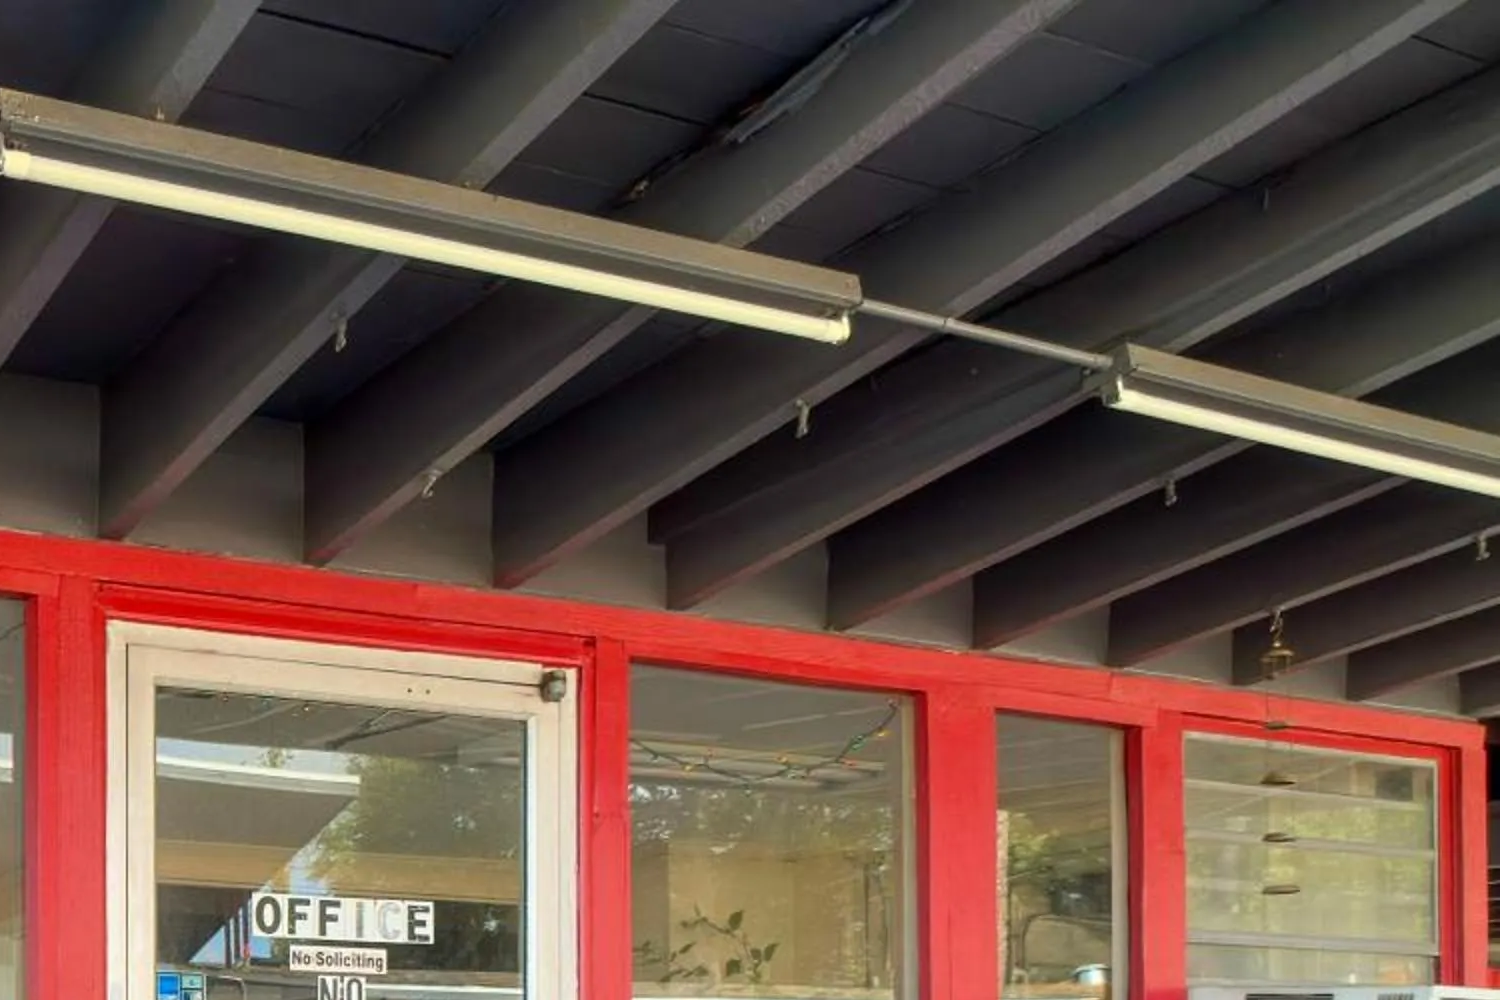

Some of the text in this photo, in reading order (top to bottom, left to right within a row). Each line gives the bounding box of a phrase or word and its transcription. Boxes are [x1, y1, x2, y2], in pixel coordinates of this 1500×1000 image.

[255, 895, 431, 943] OFFICE
[291, 950, 383, 972] No Soliciting
